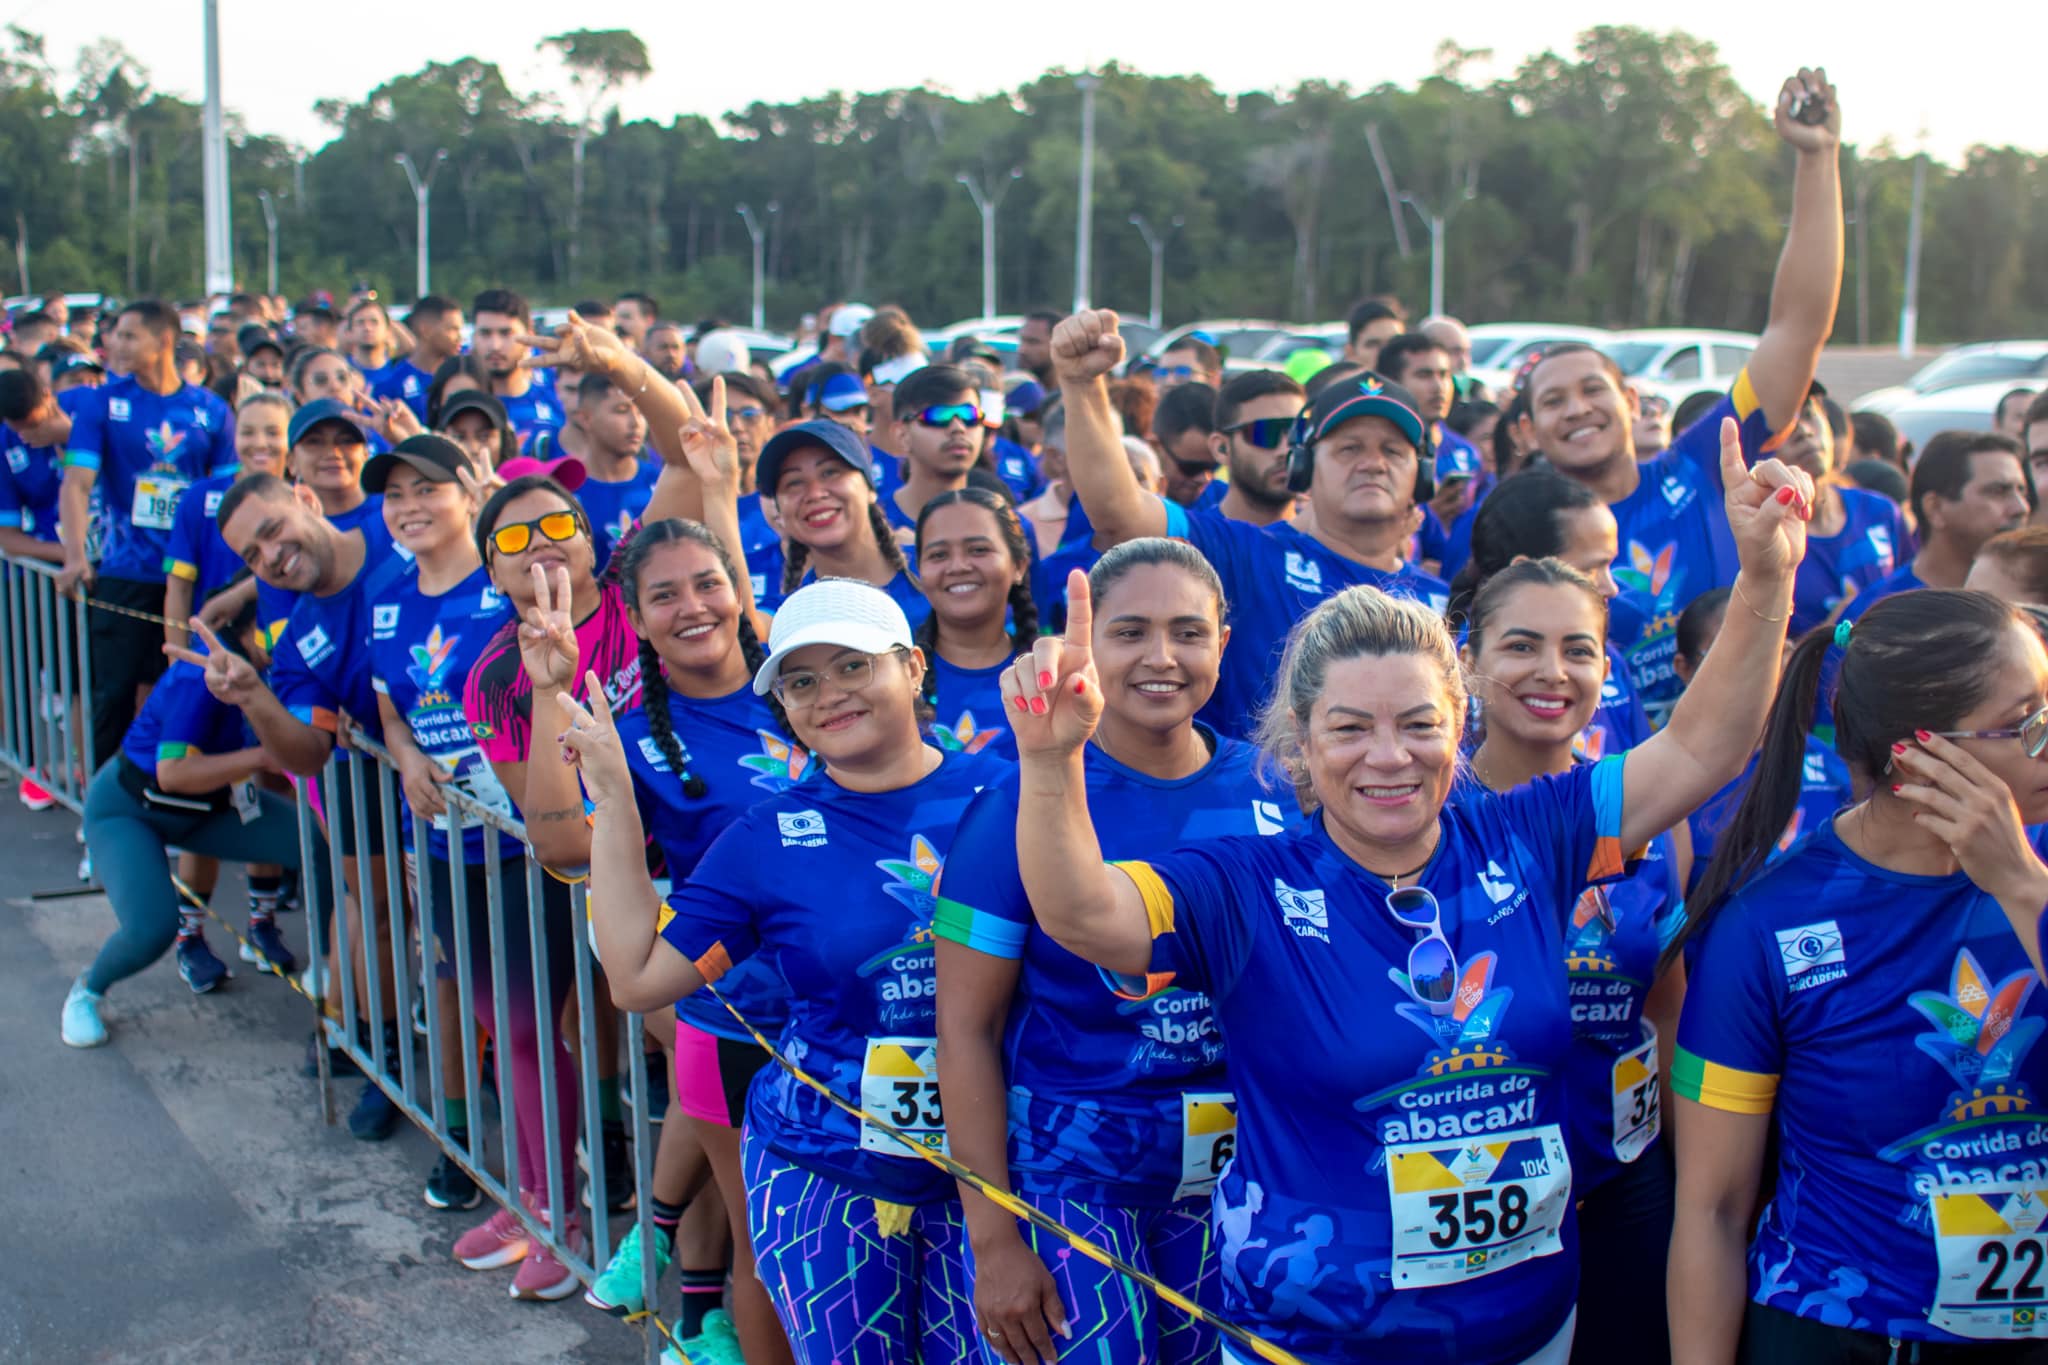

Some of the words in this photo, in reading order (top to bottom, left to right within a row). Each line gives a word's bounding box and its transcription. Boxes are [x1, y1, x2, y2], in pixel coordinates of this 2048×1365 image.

[411, 711, 451, 729] Corrida
[1605, 981, 1631, 996] do
[1570, 996, 1634, 1022] caxi
[891, 1081, 945, 1128] 33
[1399, 1082, 1495, 1109] Corrida
[1500, 1075, 1530, 1095] do
[1384, 1088, 1536, 1144] abacaxi
[1923, 1130, 2022, 1160] Corrida
[1521, 1158, 1551, 1178] 10K
[1428, 1184, 1528, 1249] 358
